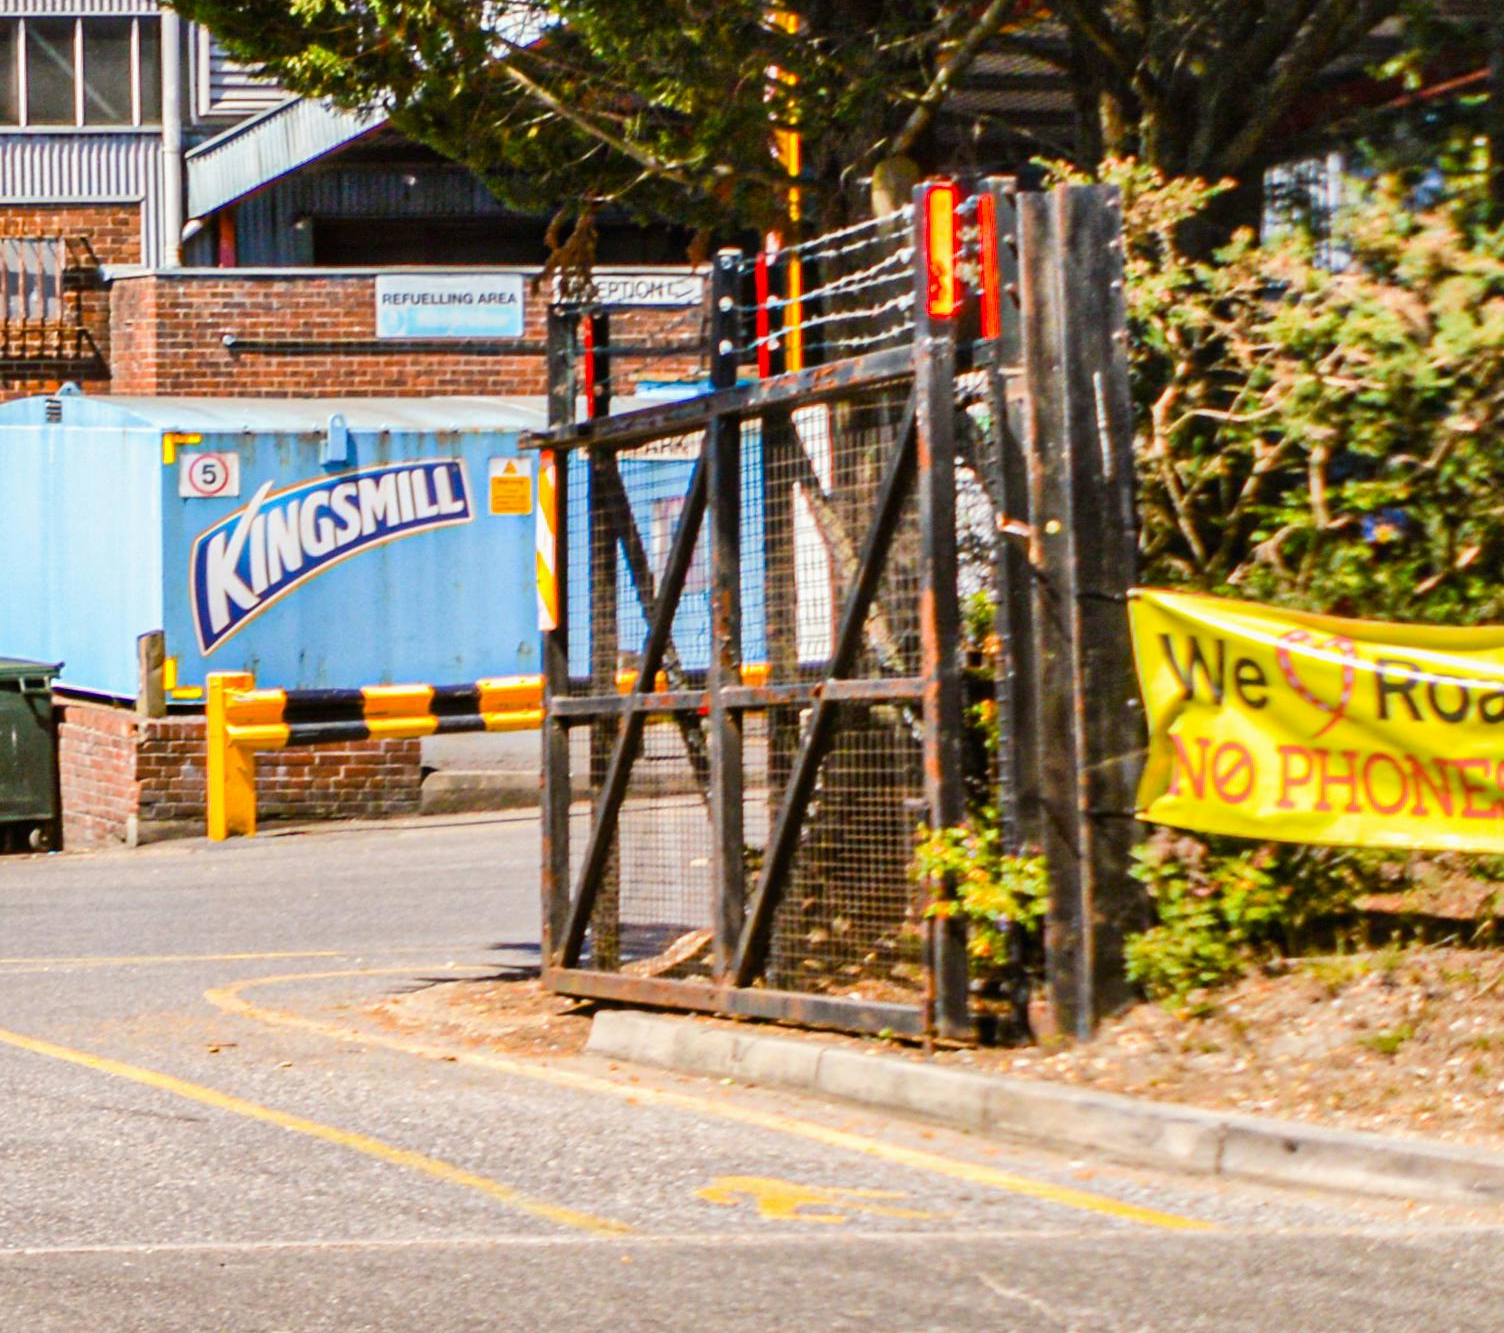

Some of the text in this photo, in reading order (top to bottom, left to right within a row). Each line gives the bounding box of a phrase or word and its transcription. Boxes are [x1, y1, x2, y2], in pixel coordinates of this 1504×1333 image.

[382, 293, 516, 305] REFUELLING AREA
[201, 463, 217, 485] 5
[206, 480, 465, 635] KINGSMILL
[1158, 633, 1270, 711] We
